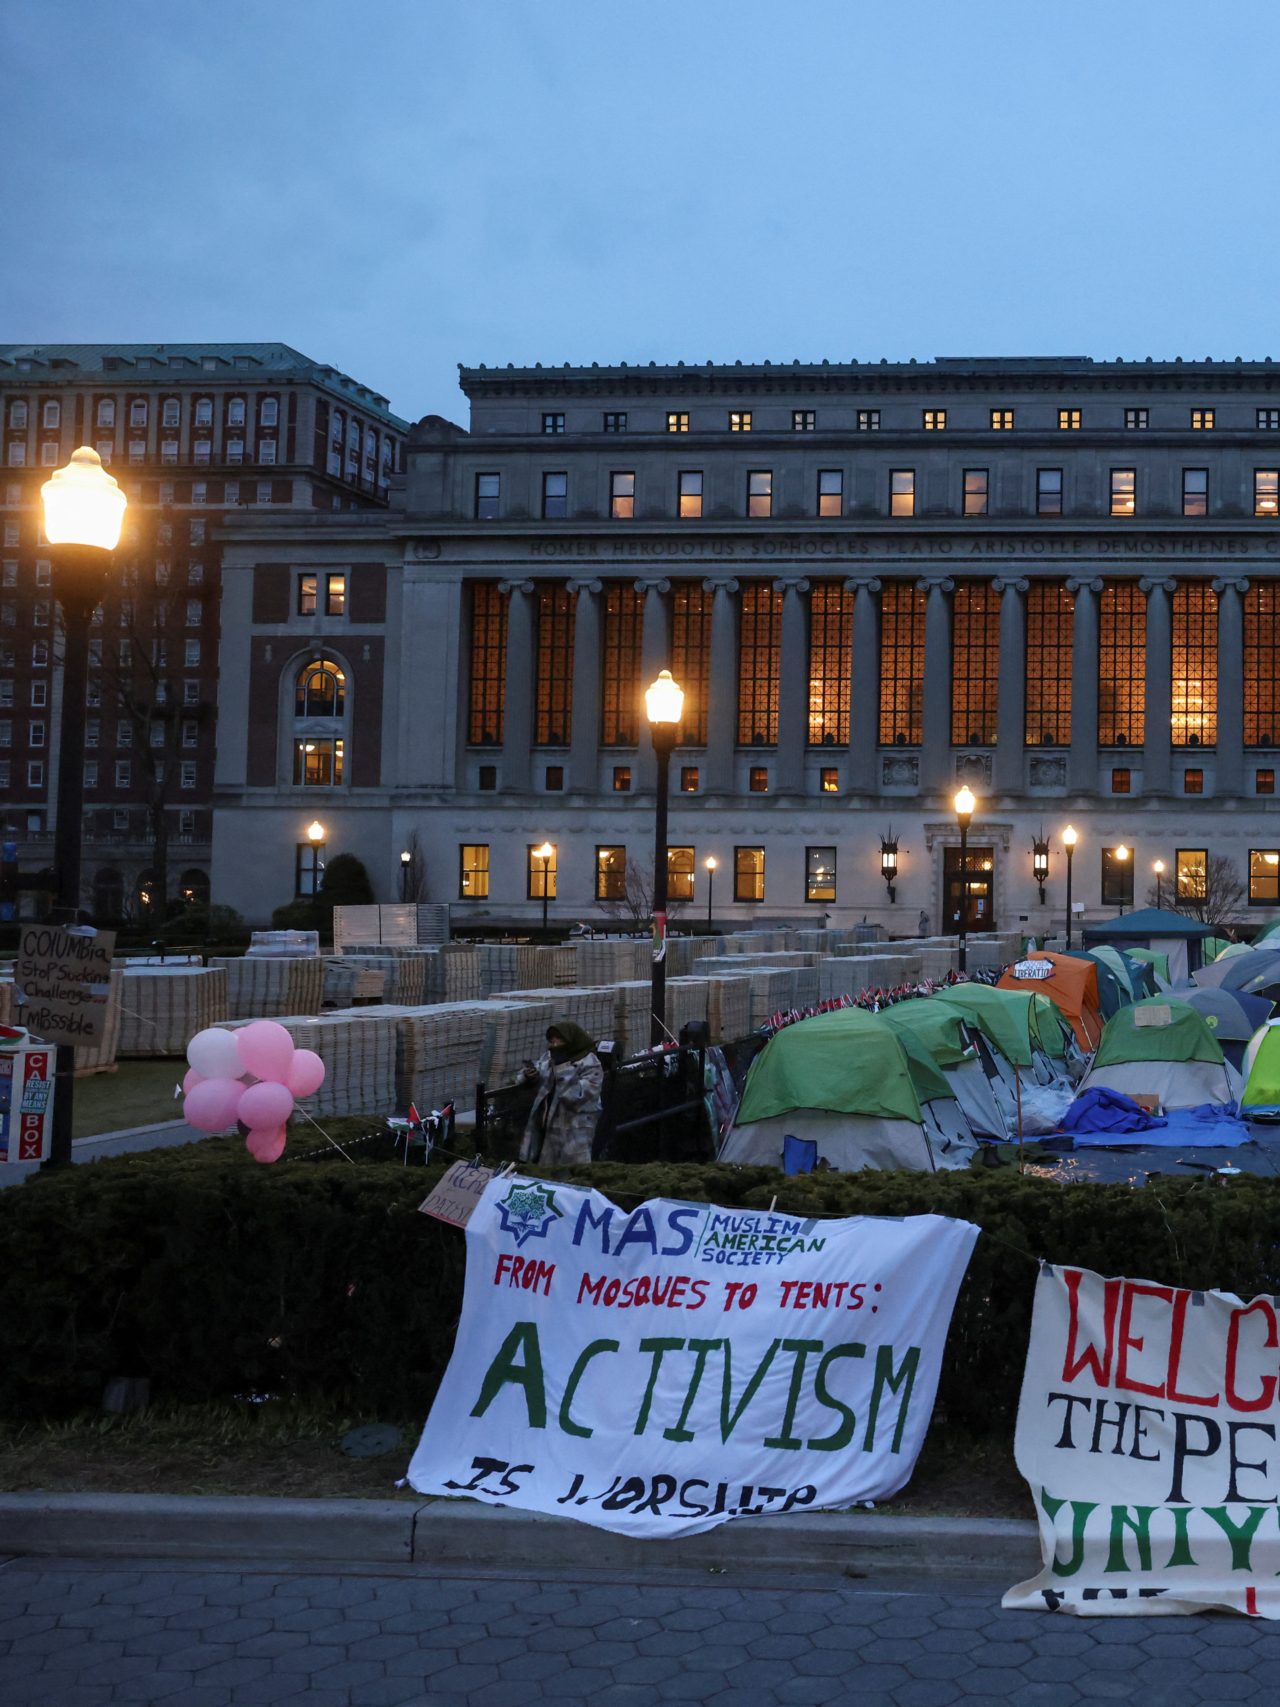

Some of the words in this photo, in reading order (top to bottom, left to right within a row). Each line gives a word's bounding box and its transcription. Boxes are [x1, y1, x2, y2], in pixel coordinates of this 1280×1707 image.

[530, 542, 599, 556] HOMER
[612, 541, 736, 556] HERODOTUS
[749, 540, 870, 555] SOPHOCLES
[886, 539, 952, 555] PLATO
[970, 539, 1082, 554] ARISTOTLE
[1101, 539, 1249, 554] DEMOSTHENES
[1014, 968, 1051, 978] LIBERATIO
[26, 1079, 50, 1089] RESIST
[22, 1100, 46, 1109] MEANS
[24, 1092, 33, 1101] BY
[34, 1092, 48, 1101] ANY
[24, 1115, 40, 1158] BOX
[572, 1200, 700, 1258] MAS
[710, 1214, 801, 1236] MUSLIM
[703, 1231, 826, 1253] AMERICAN
[701, 1247, 791, 1266] SOCIETY
[494, 1254, 556, 1296] FROM
[577, 1273, 711, 1310] MOSQUES
[723, 1281, 758, 1312] TO
[780, 1280, 883, 1314] TENTS:
[469, 1321, 921, 1455] ACTIVISM
[1047, 1391, 1164, 1462] THE
[442, 1456, 536, 1496] IS
